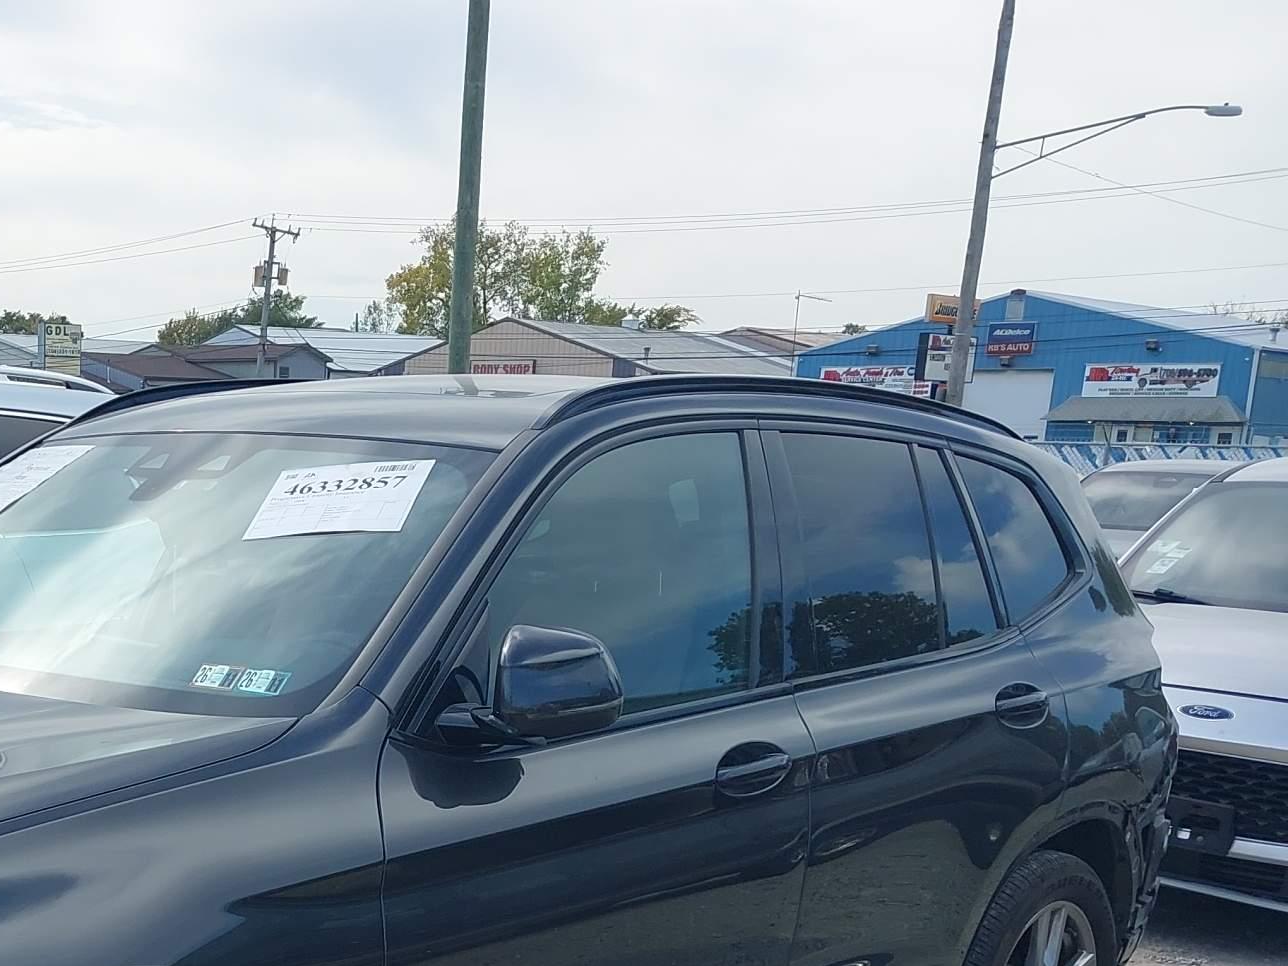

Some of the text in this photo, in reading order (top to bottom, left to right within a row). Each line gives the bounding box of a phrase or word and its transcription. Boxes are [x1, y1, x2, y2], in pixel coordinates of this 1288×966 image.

[46, 325, 69, 336] GDL
[992, 328, 1032, 336] ACDelco
[1006, 343, 1030, 351] AUTO
[473, 363, 531, 374] BODY SHOP
[284, 475, 408, 496] 46332857
[195, 667, 213, 684] 26
[240, 671, 258, 688] 26
[1189, 705, 1221, 718] Ford
